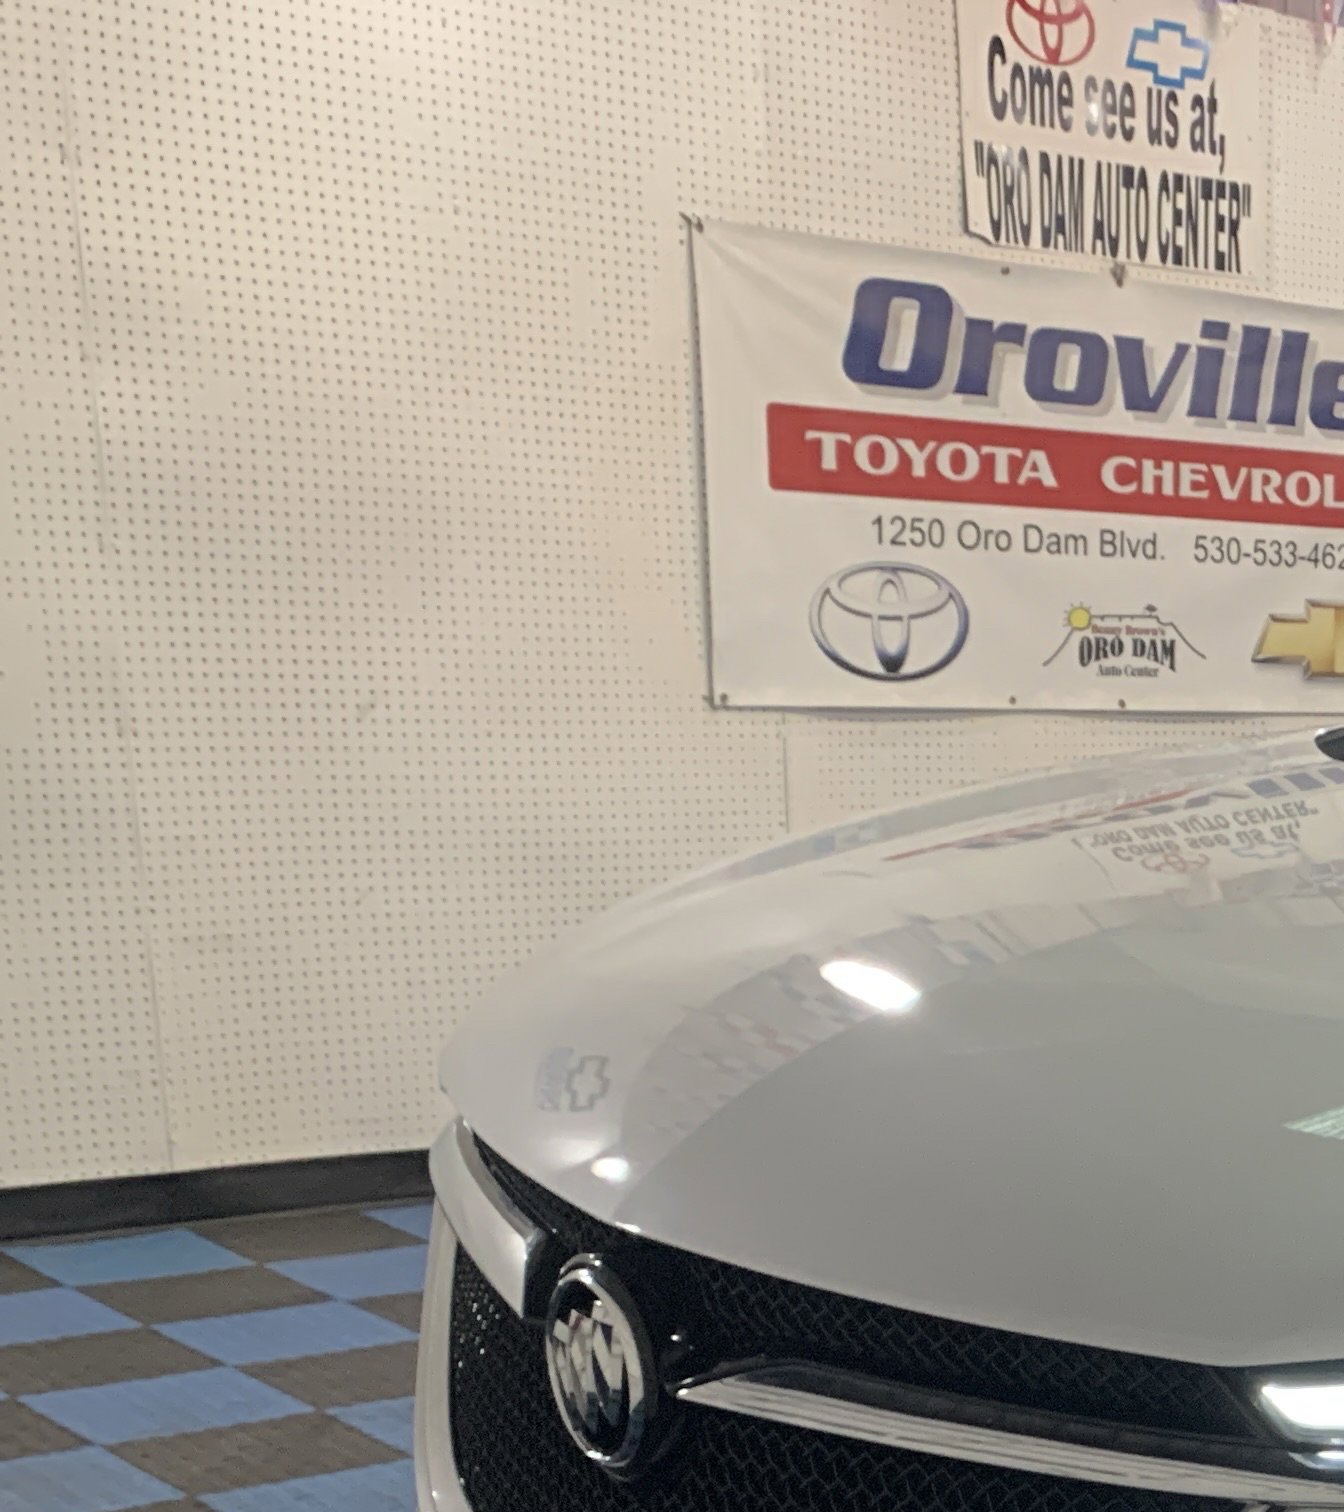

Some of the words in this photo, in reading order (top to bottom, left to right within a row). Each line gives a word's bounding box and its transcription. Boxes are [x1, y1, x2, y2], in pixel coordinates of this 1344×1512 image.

[988, 35, 1073, 132] Come
[1084, 74, 1135, 142] see
[1147, 86, 1178, 149] us
[1190, 78, 1226, 174] at,
[1039, 151, 1084, 252] DAM
[1092, 160, 1149, 262] AUTO
[1158, 169, 1251, 274] CENTER"
[805, 430, 1059, 488] TOYOTA
[871, 516, 946, 549] 1250
[957, 519, 1012, 552] Oro
[1023, 524, 1088, 557] Dam
[1099, 529, 1166, 561] Blvd.
[1079, 635, 1124, 667] ORO
[1131, 638, 1176, 672] DAM
